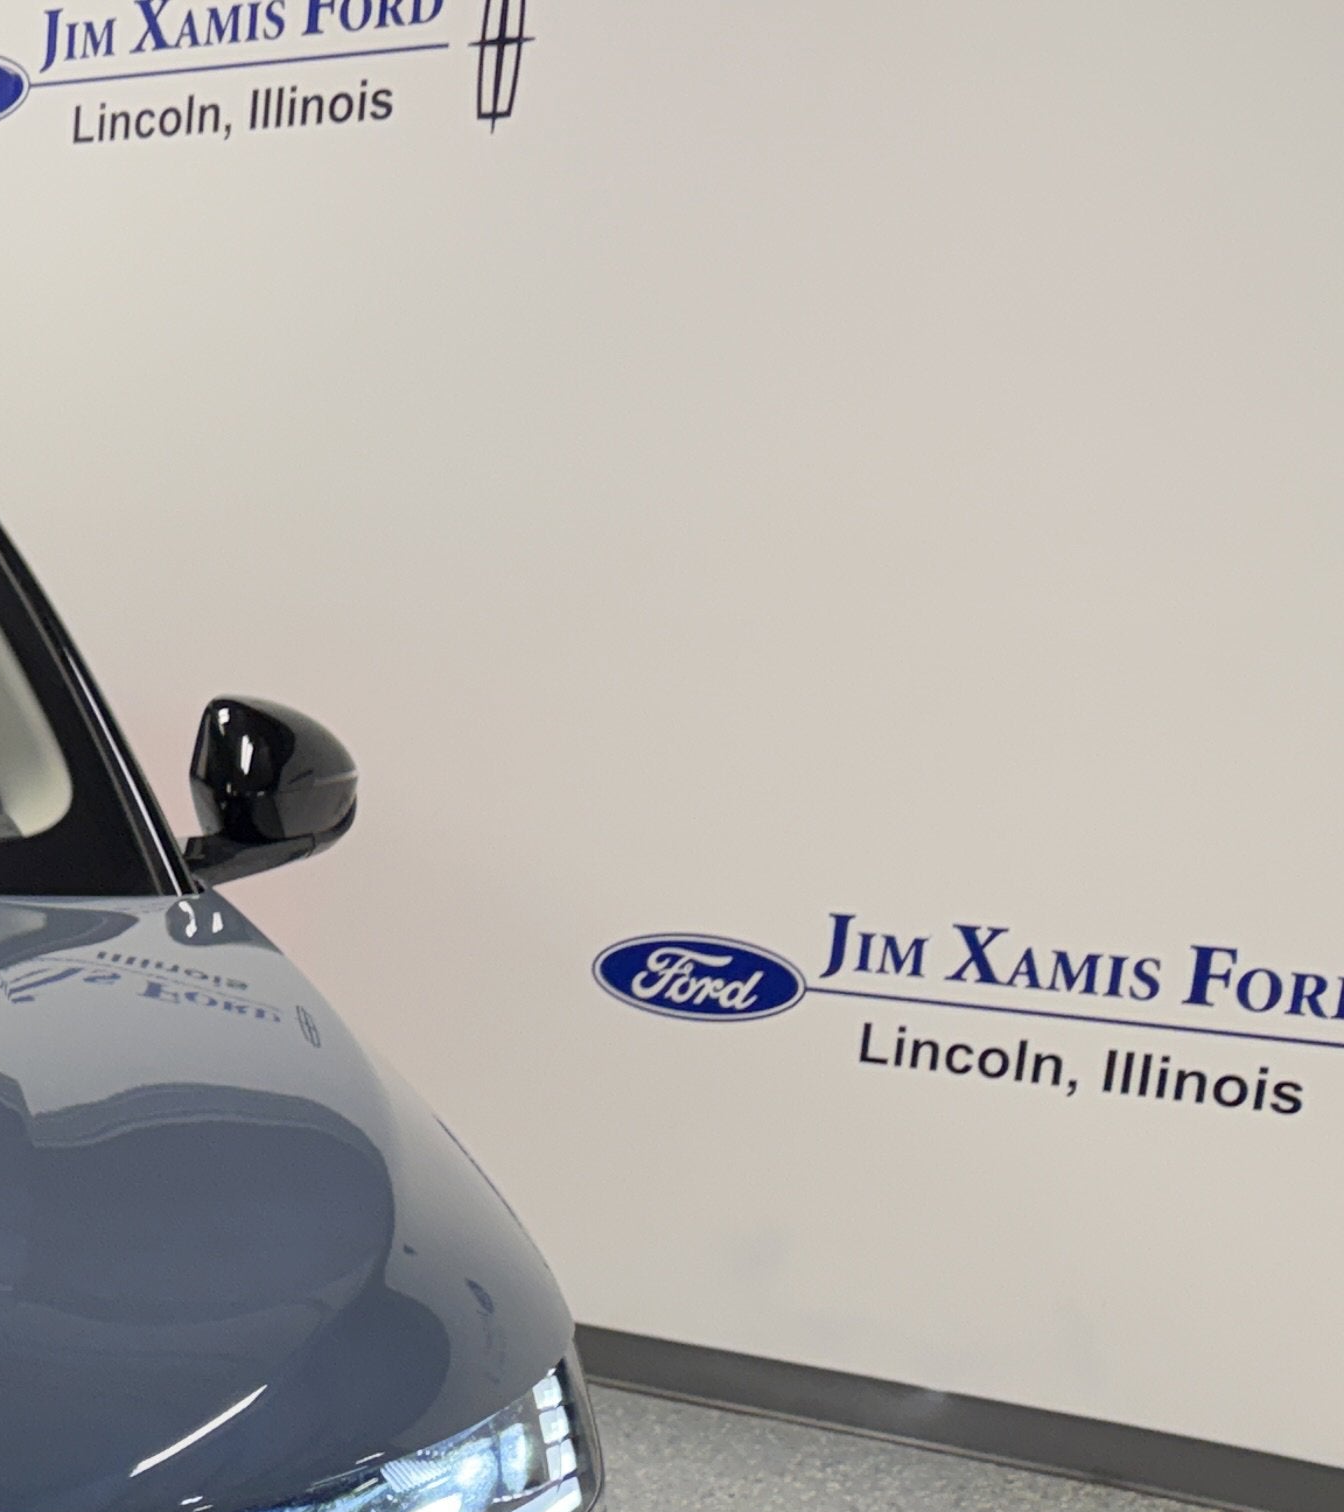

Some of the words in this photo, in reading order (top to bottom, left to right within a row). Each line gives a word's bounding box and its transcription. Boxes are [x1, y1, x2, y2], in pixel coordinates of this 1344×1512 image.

[39, 9, 117, 73] JIM
[130, 0, 285, 53] XAMIS
[73, 95, 233, 144] Lincoln,
[248, 80, 393, 131] Illinois
[631, 947, 762, 1012] Ford
[819, 912, 933, 979] JIM
[944, 923, 1161, 1000] XAMIS
[1181, 945, 1344, 1020] FOR
[859, 1022, 1079, 1096] Lincoln,
[1101, 1049, 1303, 1115] Illinois
